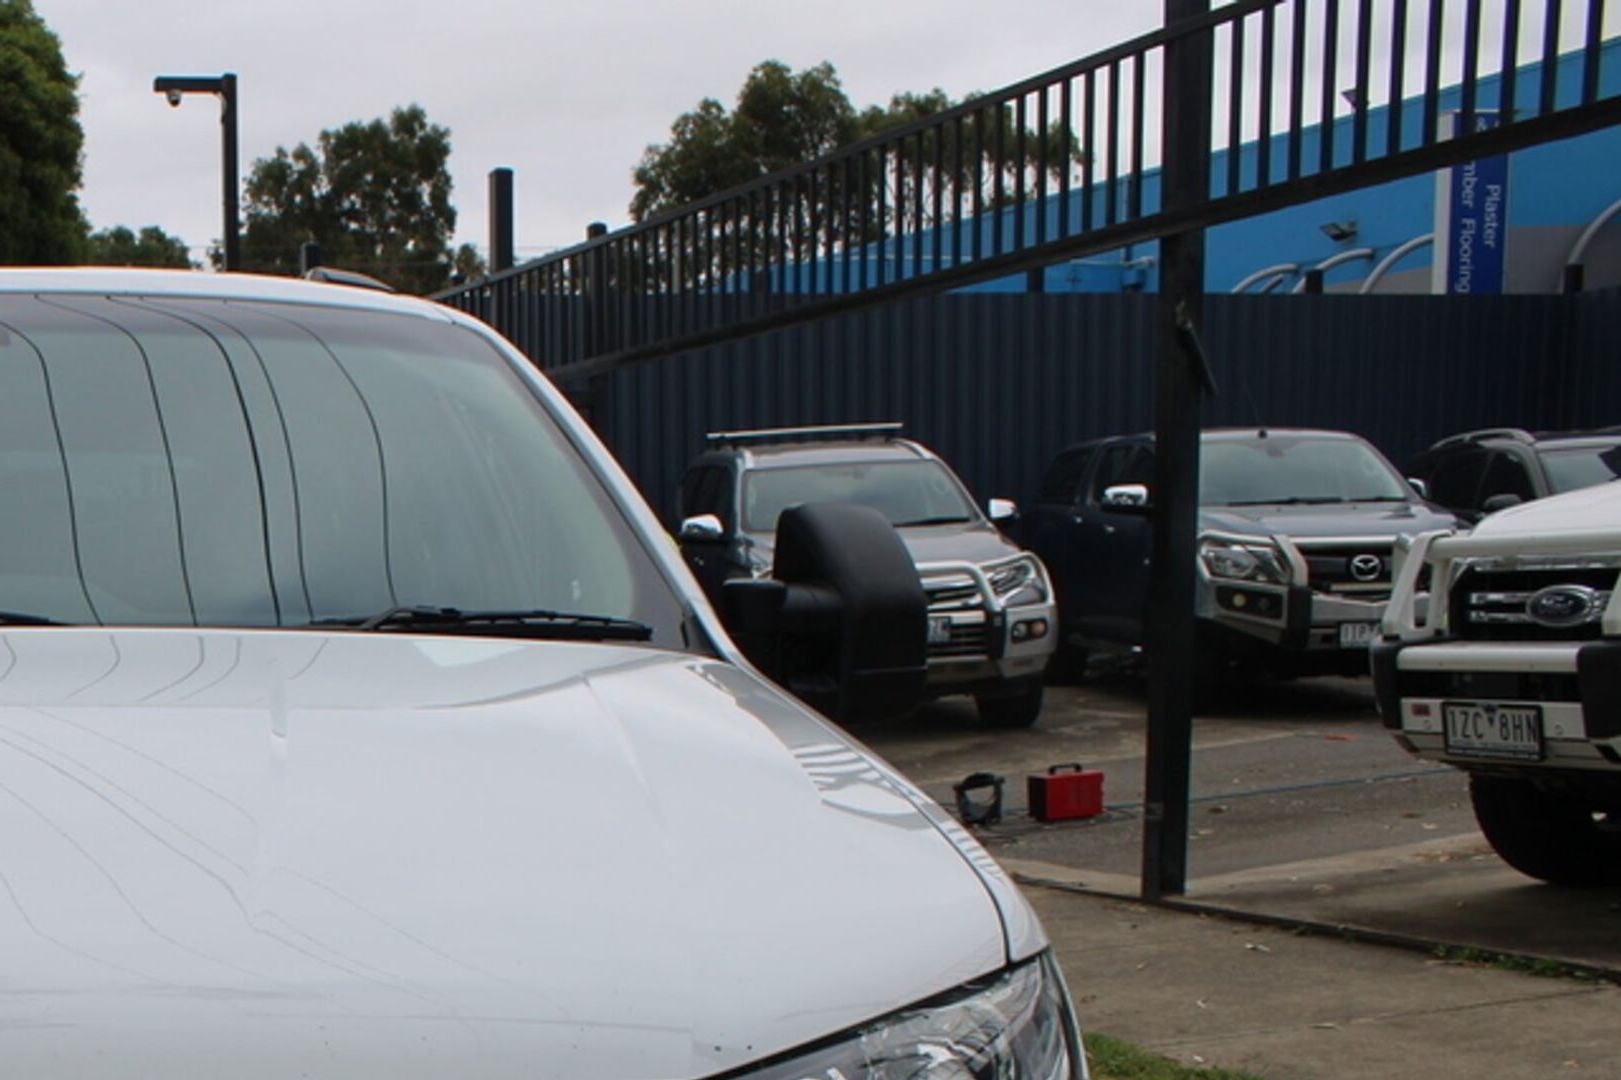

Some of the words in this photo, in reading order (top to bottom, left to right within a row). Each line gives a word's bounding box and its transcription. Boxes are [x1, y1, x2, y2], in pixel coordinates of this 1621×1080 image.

[1462, 161, 1478, 209] mber
[1483, 184, 1500, 248] Plaster
[1455, 218, 1476, 293] Flooring
